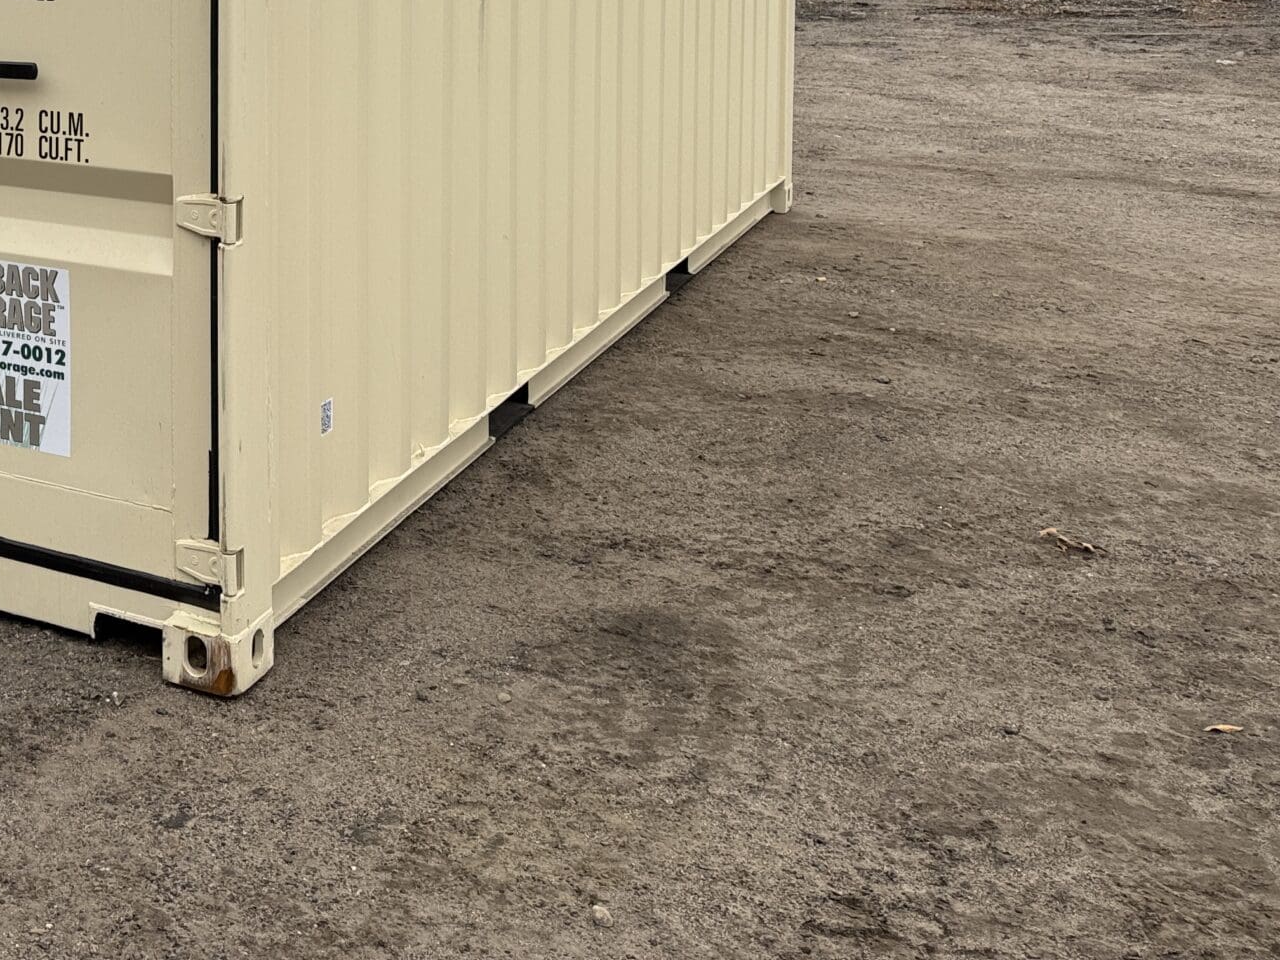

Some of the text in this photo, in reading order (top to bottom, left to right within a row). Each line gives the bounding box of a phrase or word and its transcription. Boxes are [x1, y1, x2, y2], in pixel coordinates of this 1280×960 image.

[38, 109, 90, 138] CU.M.
[38, 137, 90, 164] CU.FT.
[34, 335, 46, 344] ON
[49, 337, 67, 347] SITE
